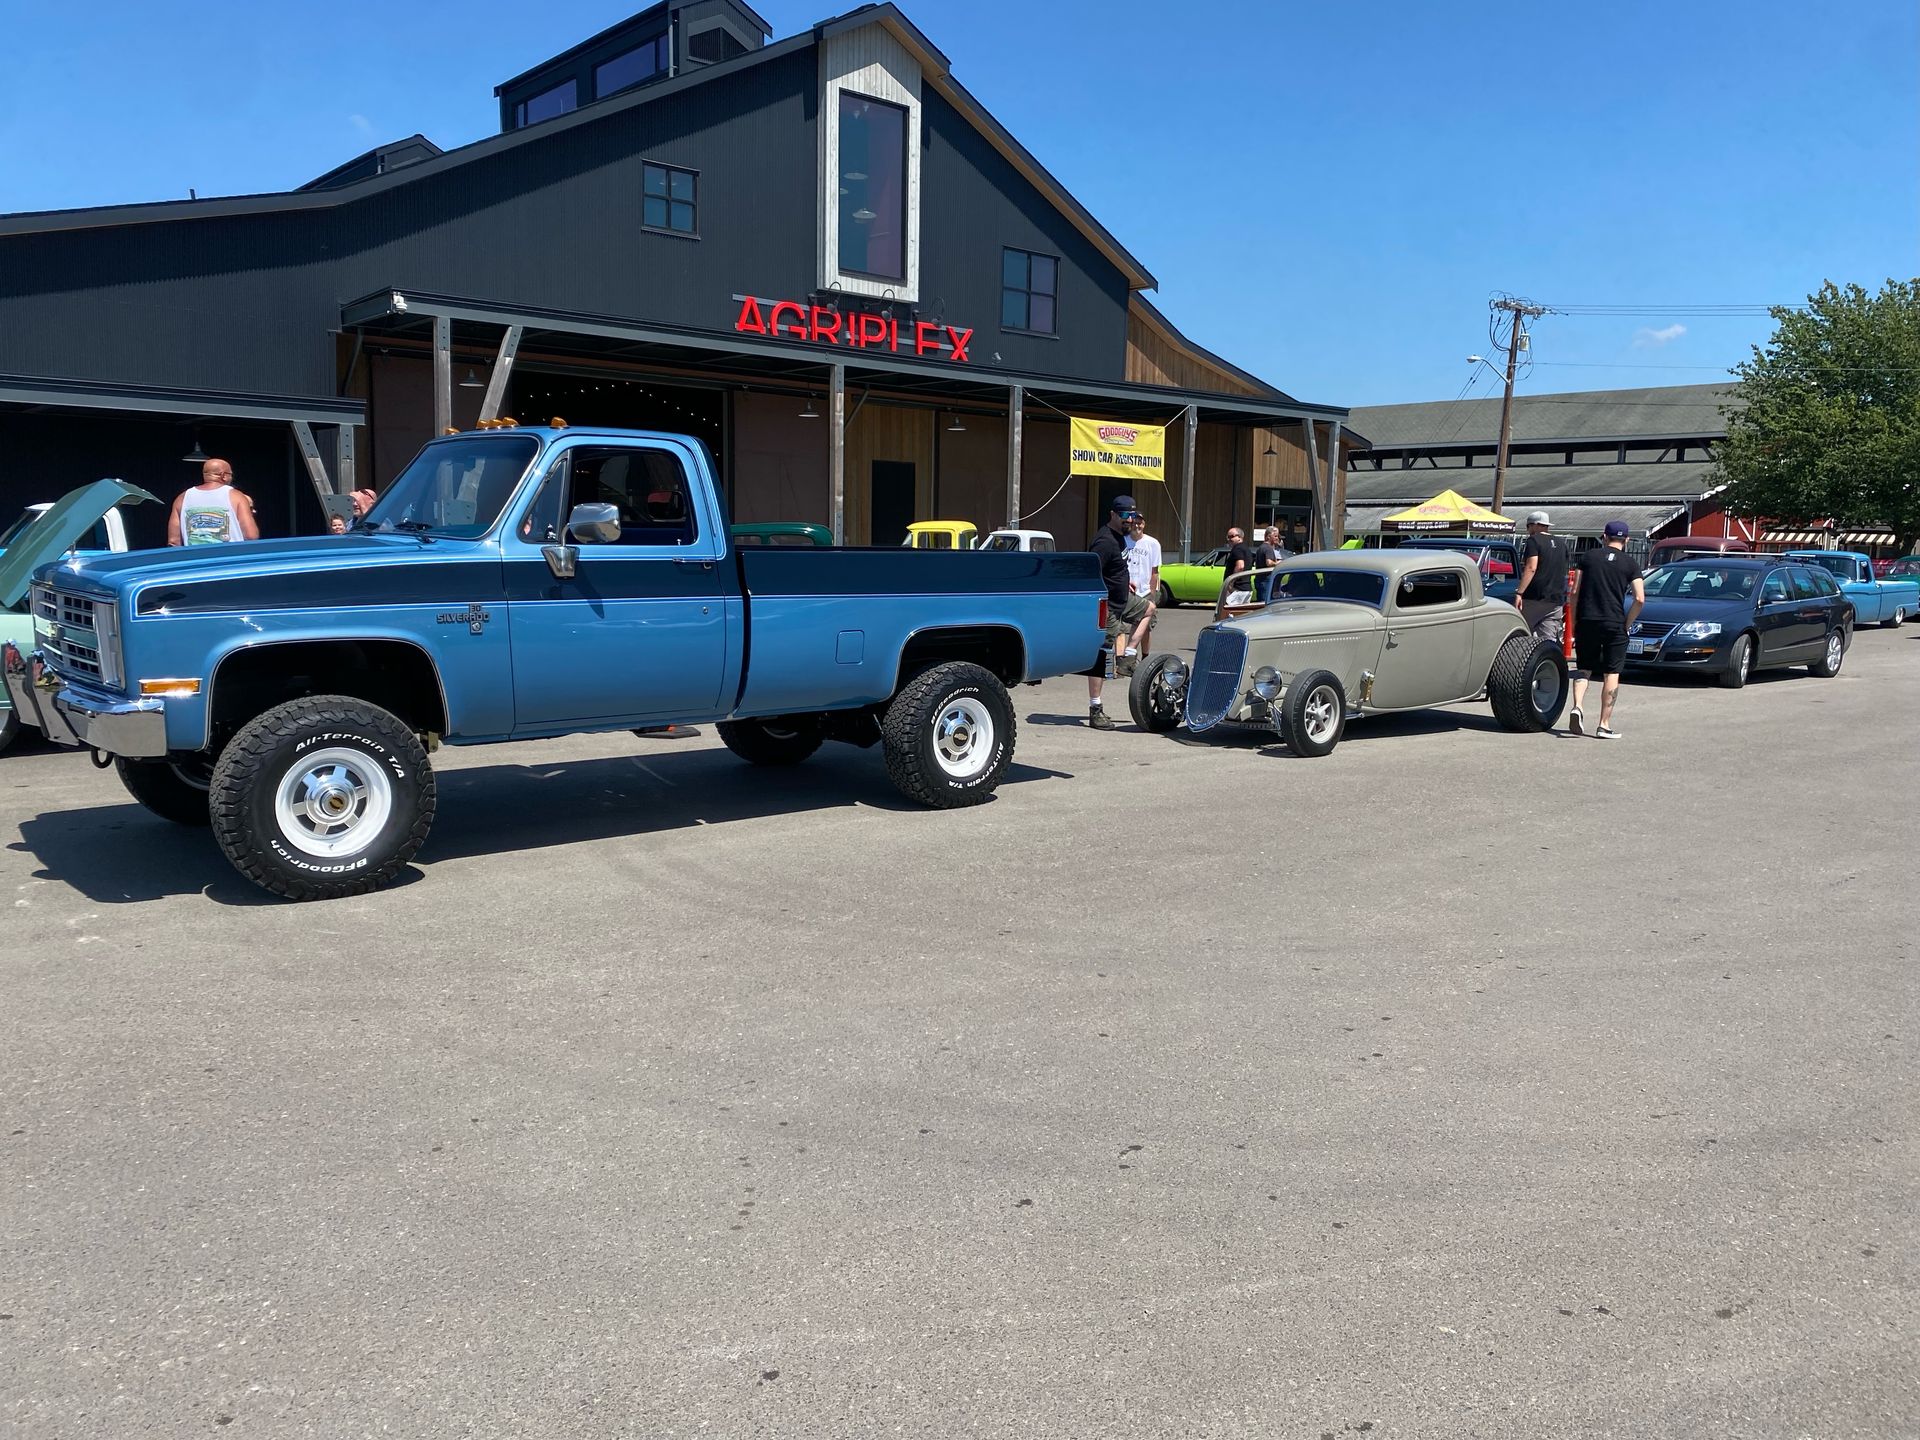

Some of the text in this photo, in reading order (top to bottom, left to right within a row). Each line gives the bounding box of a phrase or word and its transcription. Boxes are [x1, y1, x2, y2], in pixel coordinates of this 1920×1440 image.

[1098, 427, 1139, 442] GOODGUYS
[1072, 449, 1162, 468] SHOW CAR REGISTRATION
[437, 613, 490, 624] SILVERADO
[930, 687, 980, 725] BFGoodrich
[295, 732, 405, 779] All-Terrain T/A
[948, 743, 1004, 789] All-Terrain T/A
[269, 839, 368, 874] BFGoodrich
